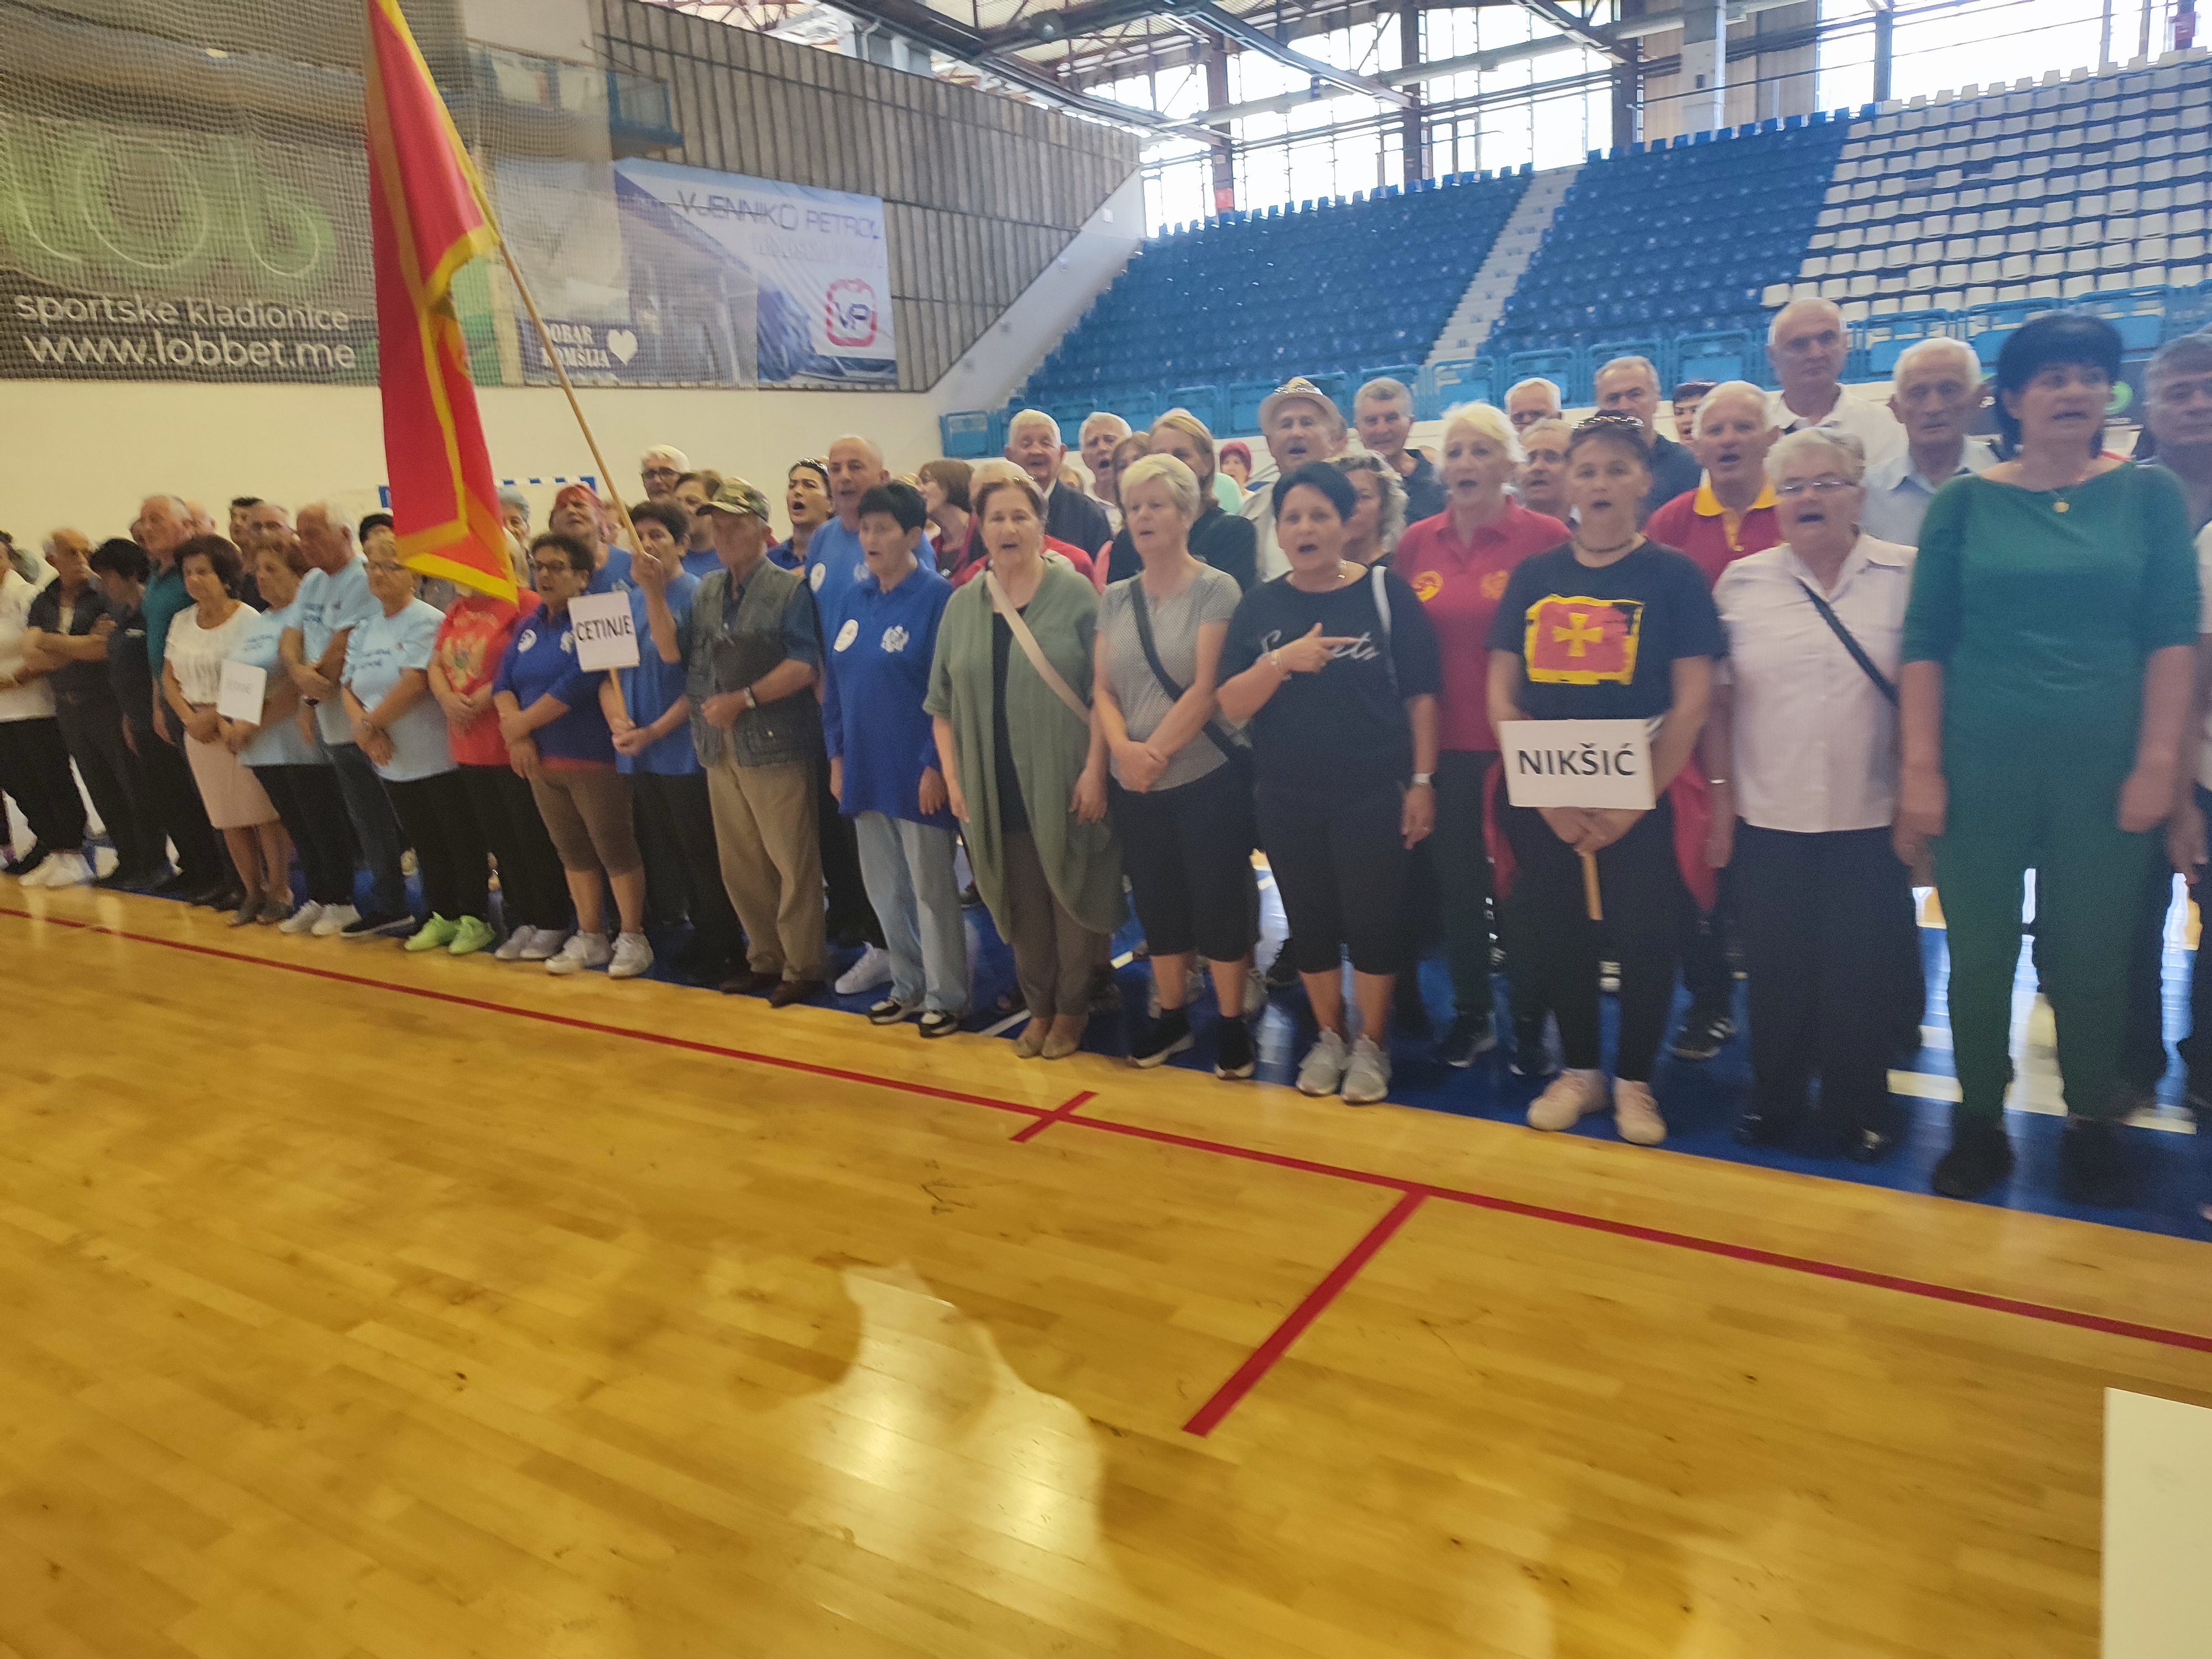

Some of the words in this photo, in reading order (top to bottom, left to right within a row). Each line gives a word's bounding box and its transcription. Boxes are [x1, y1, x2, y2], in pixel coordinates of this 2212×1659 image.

[14, 293, 179, 327] sportske
[184, 296, 351, 332] kladionice
[21, 328, 357, 369] www.lobbet.me
[575, 614, 634, 642] CETINJE
[1516, 742, 1637, 776] NIKŠIĆ
